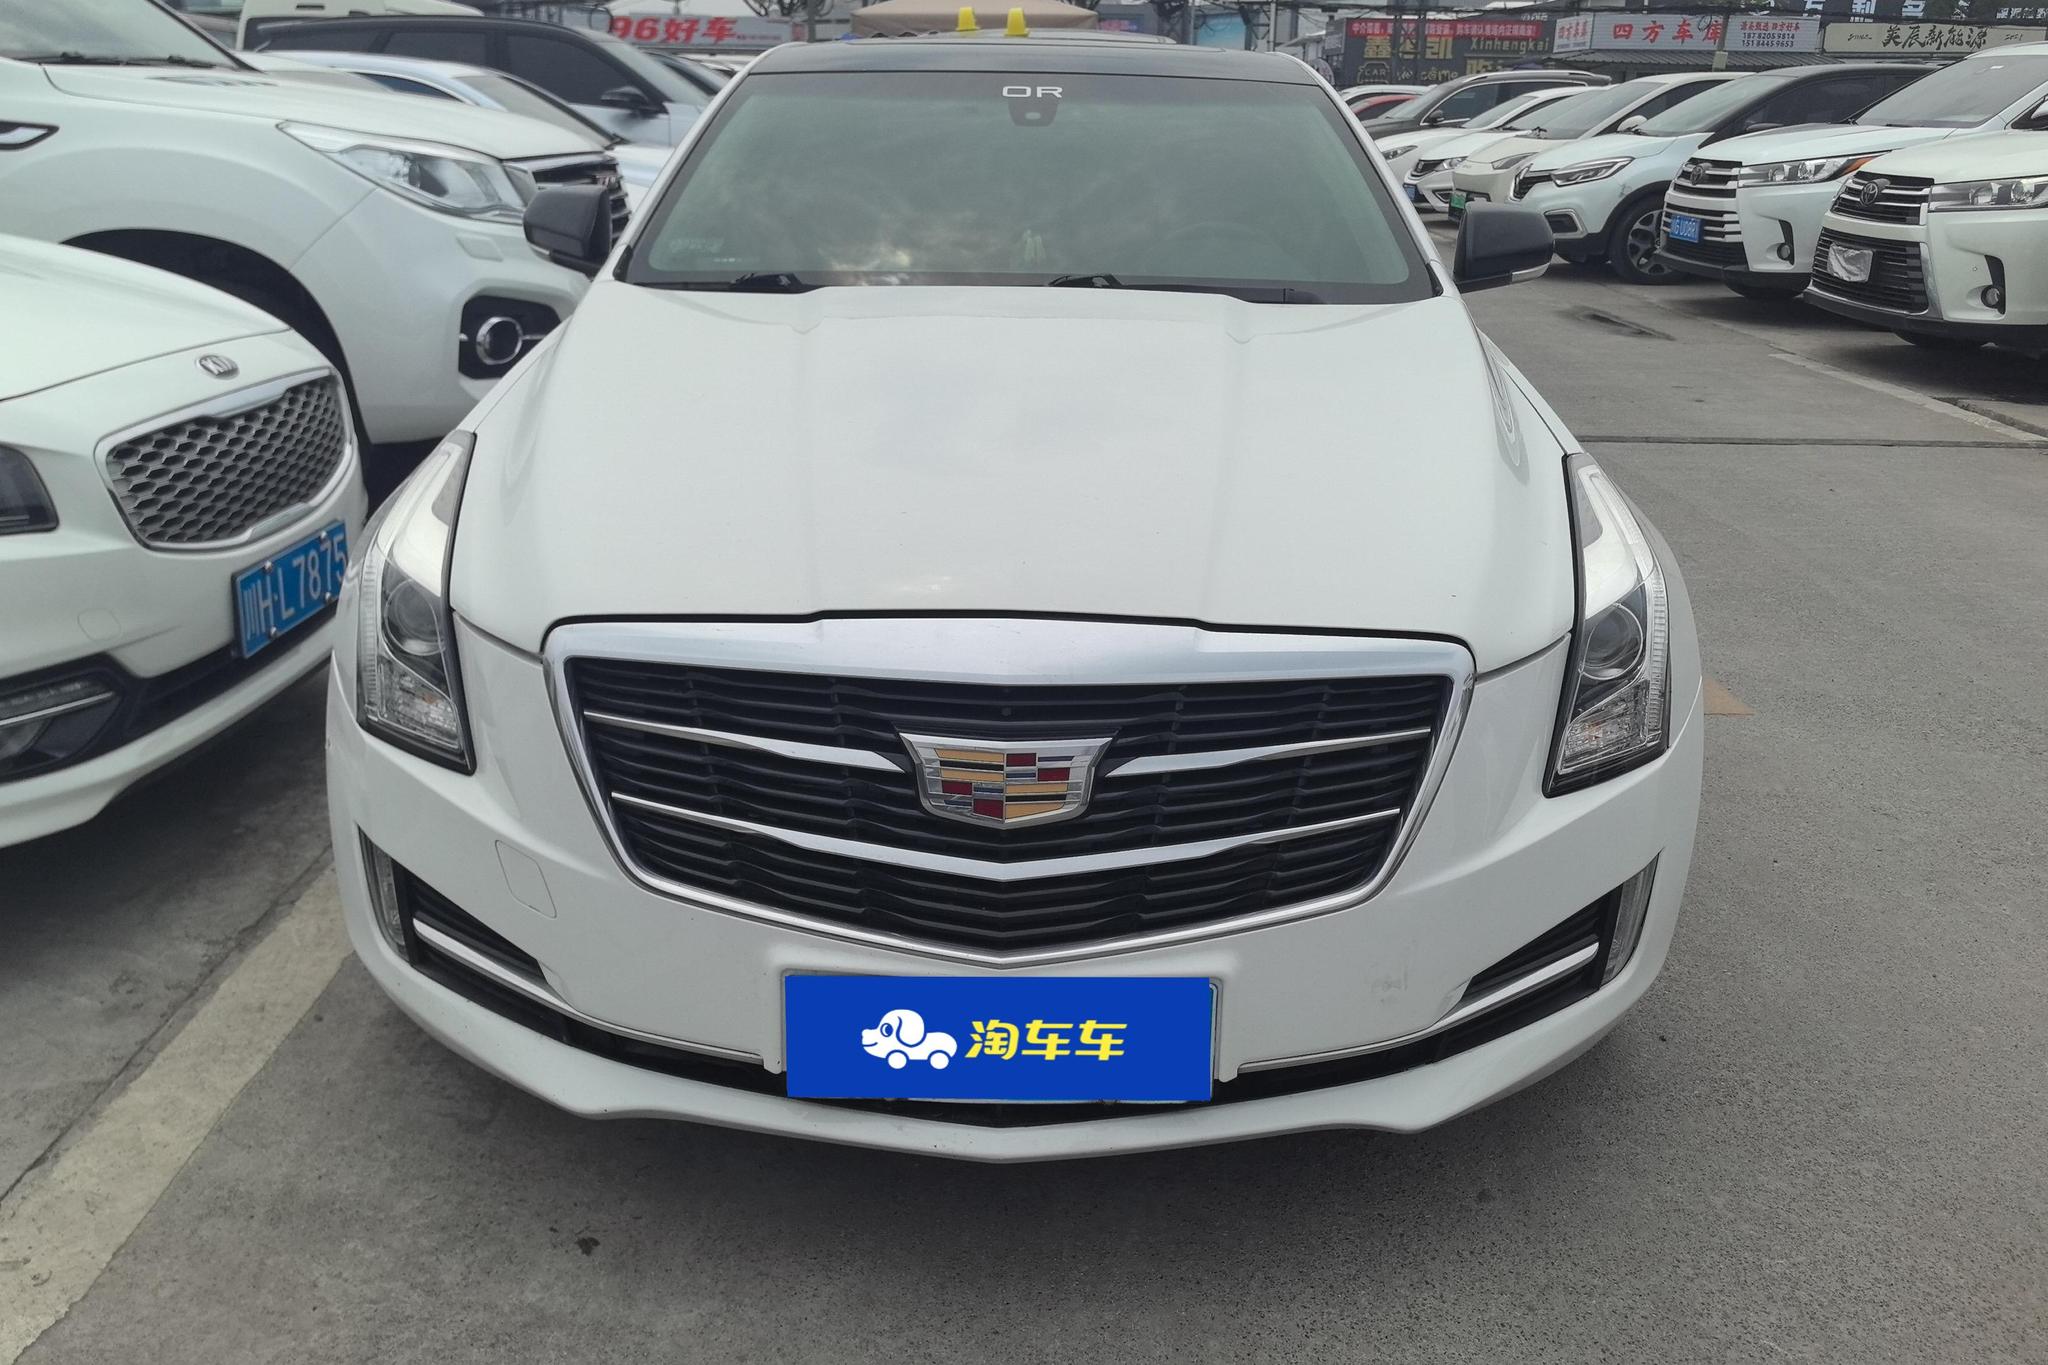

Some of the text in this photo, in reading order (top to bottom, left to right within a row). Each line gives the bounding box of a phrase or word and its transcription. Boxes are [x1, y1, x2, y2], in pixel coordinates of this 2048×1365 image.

[610, 16, 737, 44] 96好车
[1612, 17, 1722, 45] 四方车库
[1471, 36, 1549, 54] Xinhengkai
[1002, 85, 1063, 98] OR
